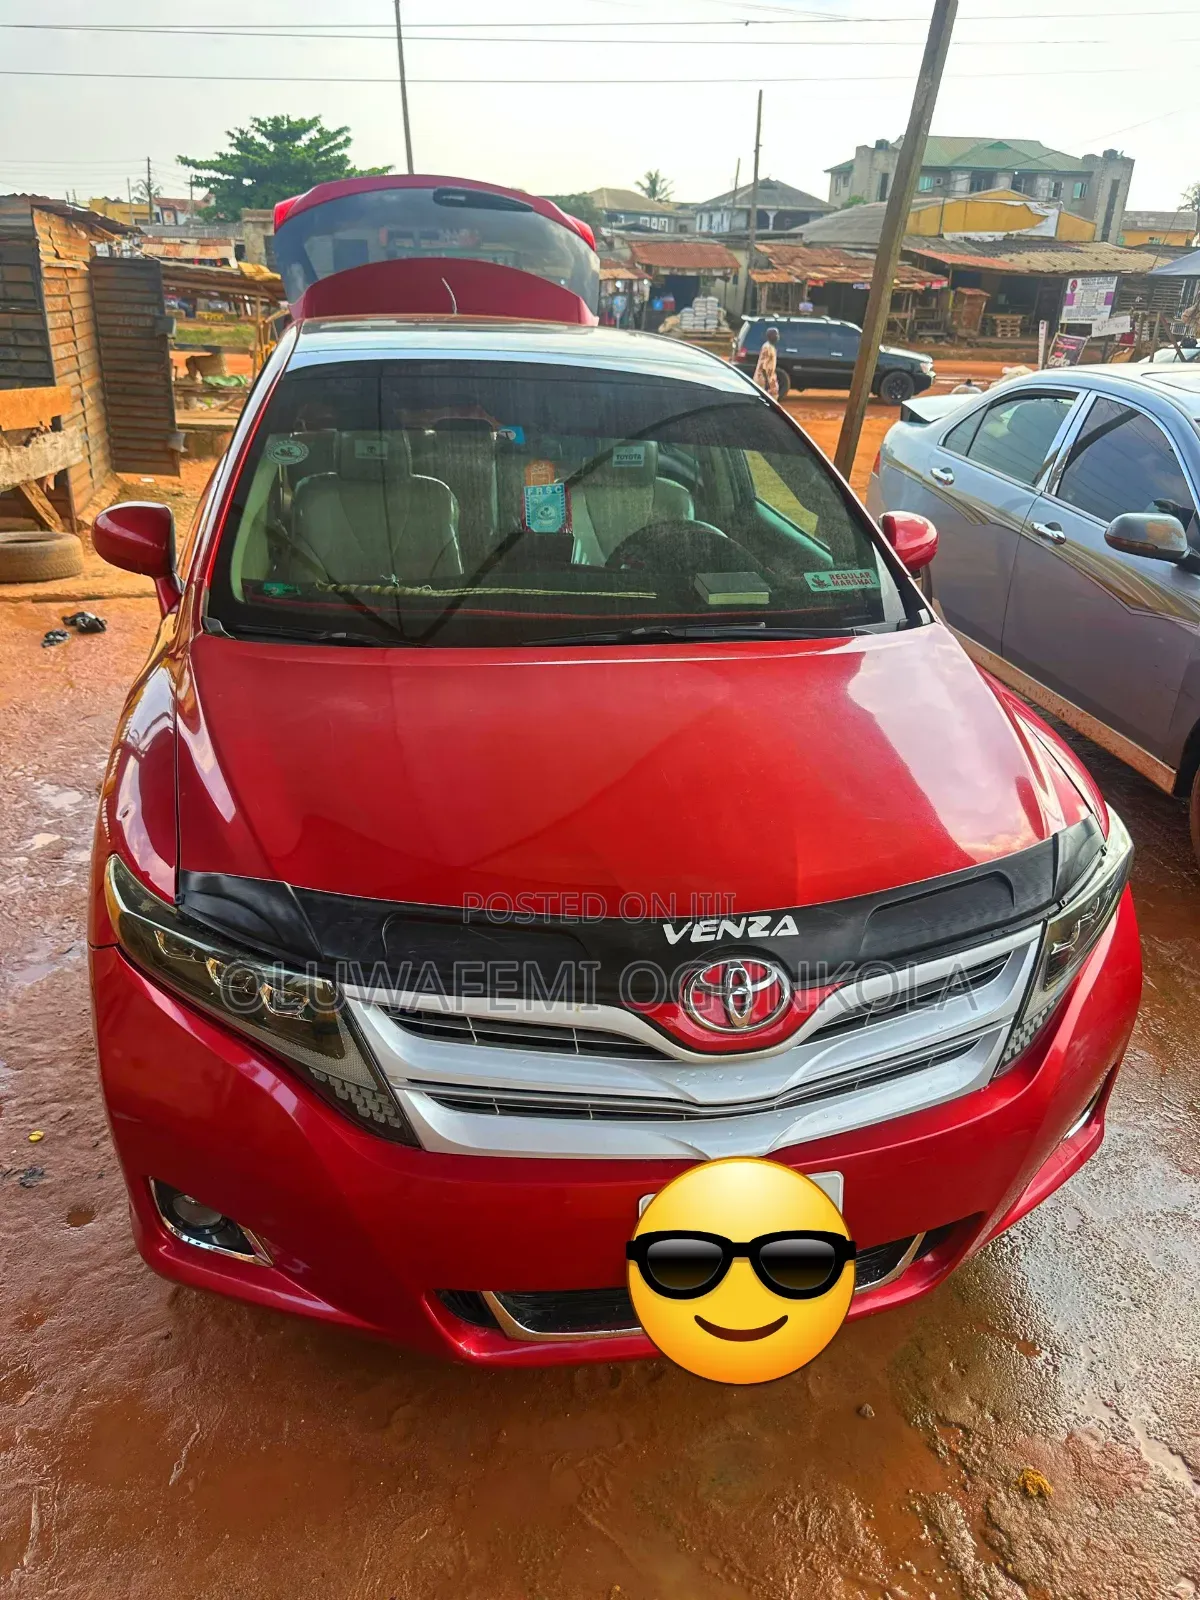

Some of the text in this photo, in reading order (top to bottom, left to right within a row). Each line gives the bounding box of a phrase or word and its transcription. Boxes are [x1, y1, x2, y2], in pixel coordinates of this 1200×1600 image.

[616, 453, 642, 461] TOYOTA
[828, 571, 872, 580] REGULAR
[831, 578, 876, 587] MARSHAL
[662, 914, 800, 945] VENZA
